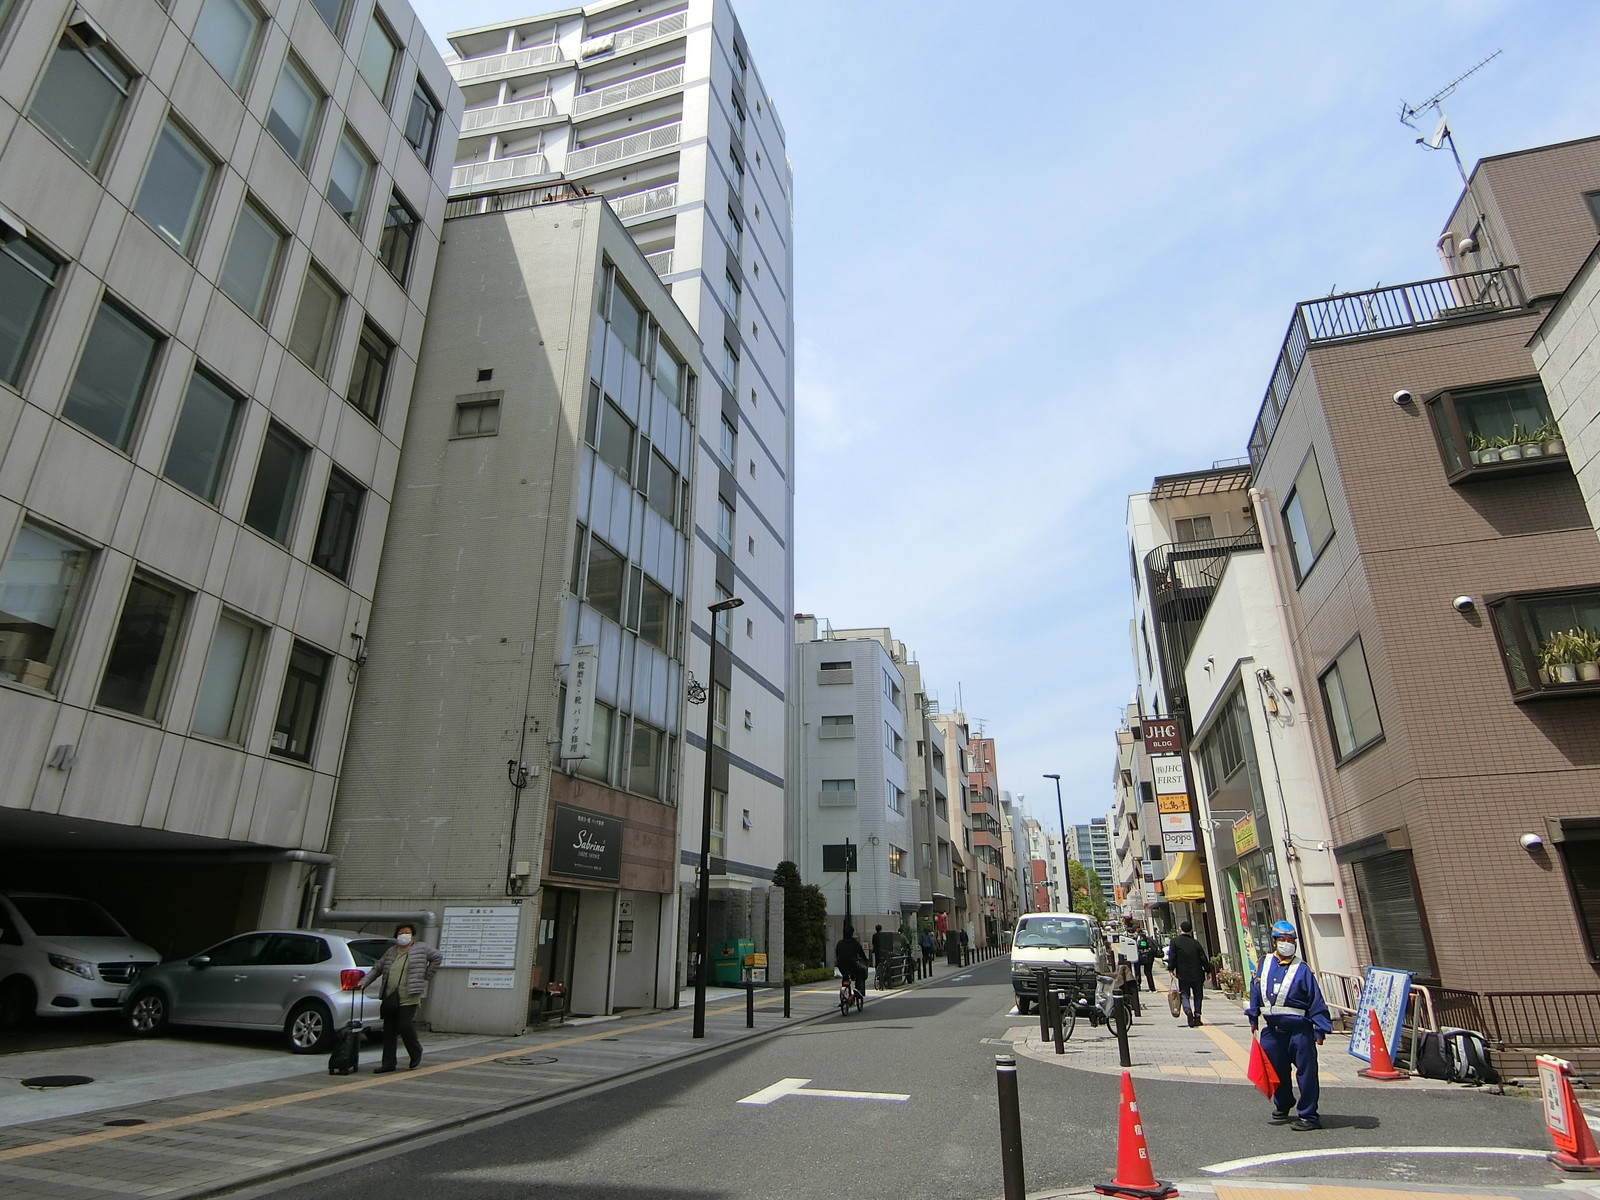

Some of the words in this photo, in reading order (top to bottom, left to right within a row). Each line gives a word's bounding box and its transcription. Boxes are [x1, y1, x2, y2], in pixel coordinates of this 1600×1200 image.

[1145, 725, 1176, 739] JHC
[1158, 775, 1183, 784] FIRST
[573, 829, 606, 853] Sabrina
